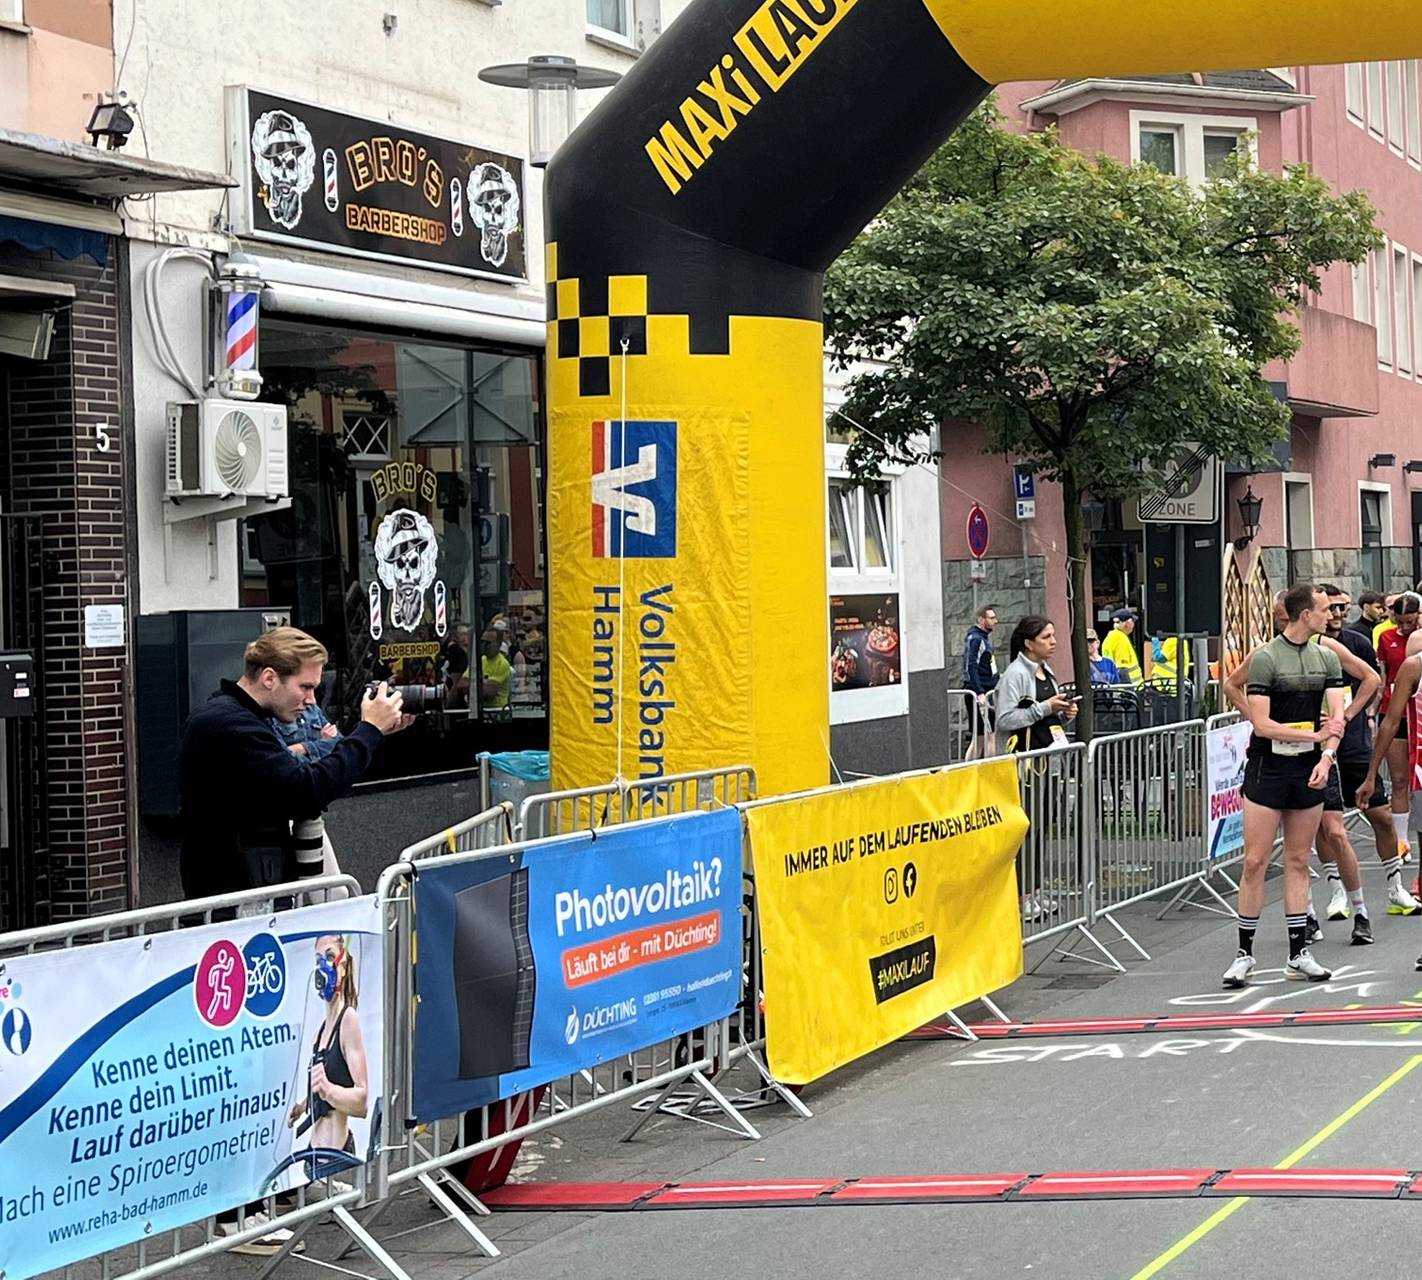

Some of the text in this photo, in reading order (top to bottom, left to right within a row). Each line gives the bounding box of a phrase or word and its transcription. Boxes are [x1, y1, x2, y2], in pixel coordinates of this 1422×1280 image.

[644, 0, 848, 195] MAXi LAU
[346, 204, 448, 245] BARBERSHOP
[96, 423, 110, 452] 5
[1158, 503, 1196, 516] ZONE
[380, 641, 441, 660] BARBERSHOP
[593, 586, 621, 724] Hamm
[639, 583, 676, 807] Volksbank
[784, 805, 1003, 877] IMMER AUF DEM LAUFENDEN BLEIBEN
[555, 857, 722, 936] Photovoltaik?
[566, 954, 598, 980] Läuft
[600, 946, 617, 970] bei
[618, 942, 631, 964] dir
[641, 934, 661, 957] mit
[664, 919, 718, 950] Düchting!
[583, 998, 637, 1032] DÜCHTING
[93, 1022, 297, 1089] Kenne deinen Atem.
[949, 1039, 1249, 1065] START
[48, 1066, 238, 1135] Kenne dein Limit.
[71, 1082, 287, 1164] Lauf darüber hinaus!
[53, 1176, 100, 1207] eine
[108, 1118, 276, 1196] Spiroergometrie!
[49, 1180, 208, 1244] www.reha-bad-hamm.de
